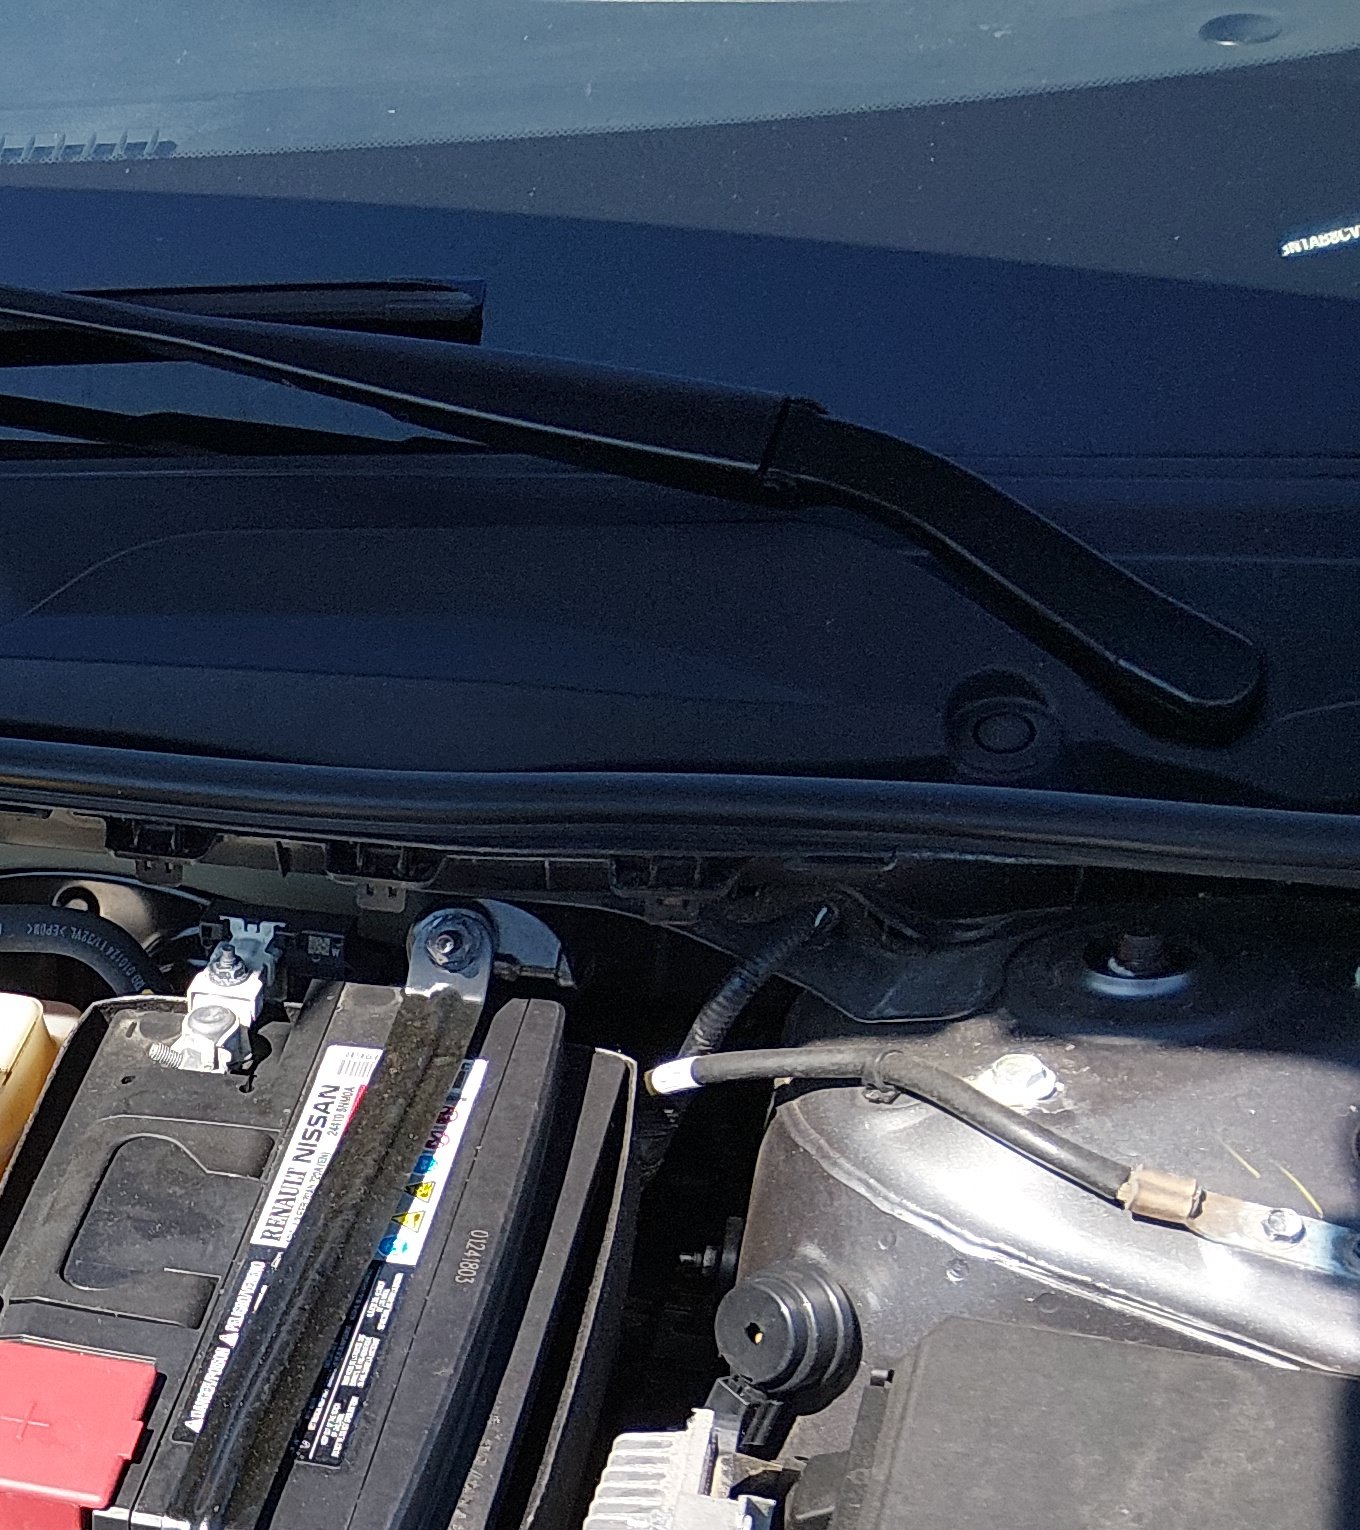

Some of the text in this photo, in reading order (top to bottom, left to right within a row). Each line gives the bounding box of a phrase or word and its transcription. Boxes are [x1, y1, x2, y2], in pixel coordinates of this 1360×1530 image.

[260, 1084, 341, 1242] RENAULT NISSAN
[454, 1229, 489, 1285] 01241803
